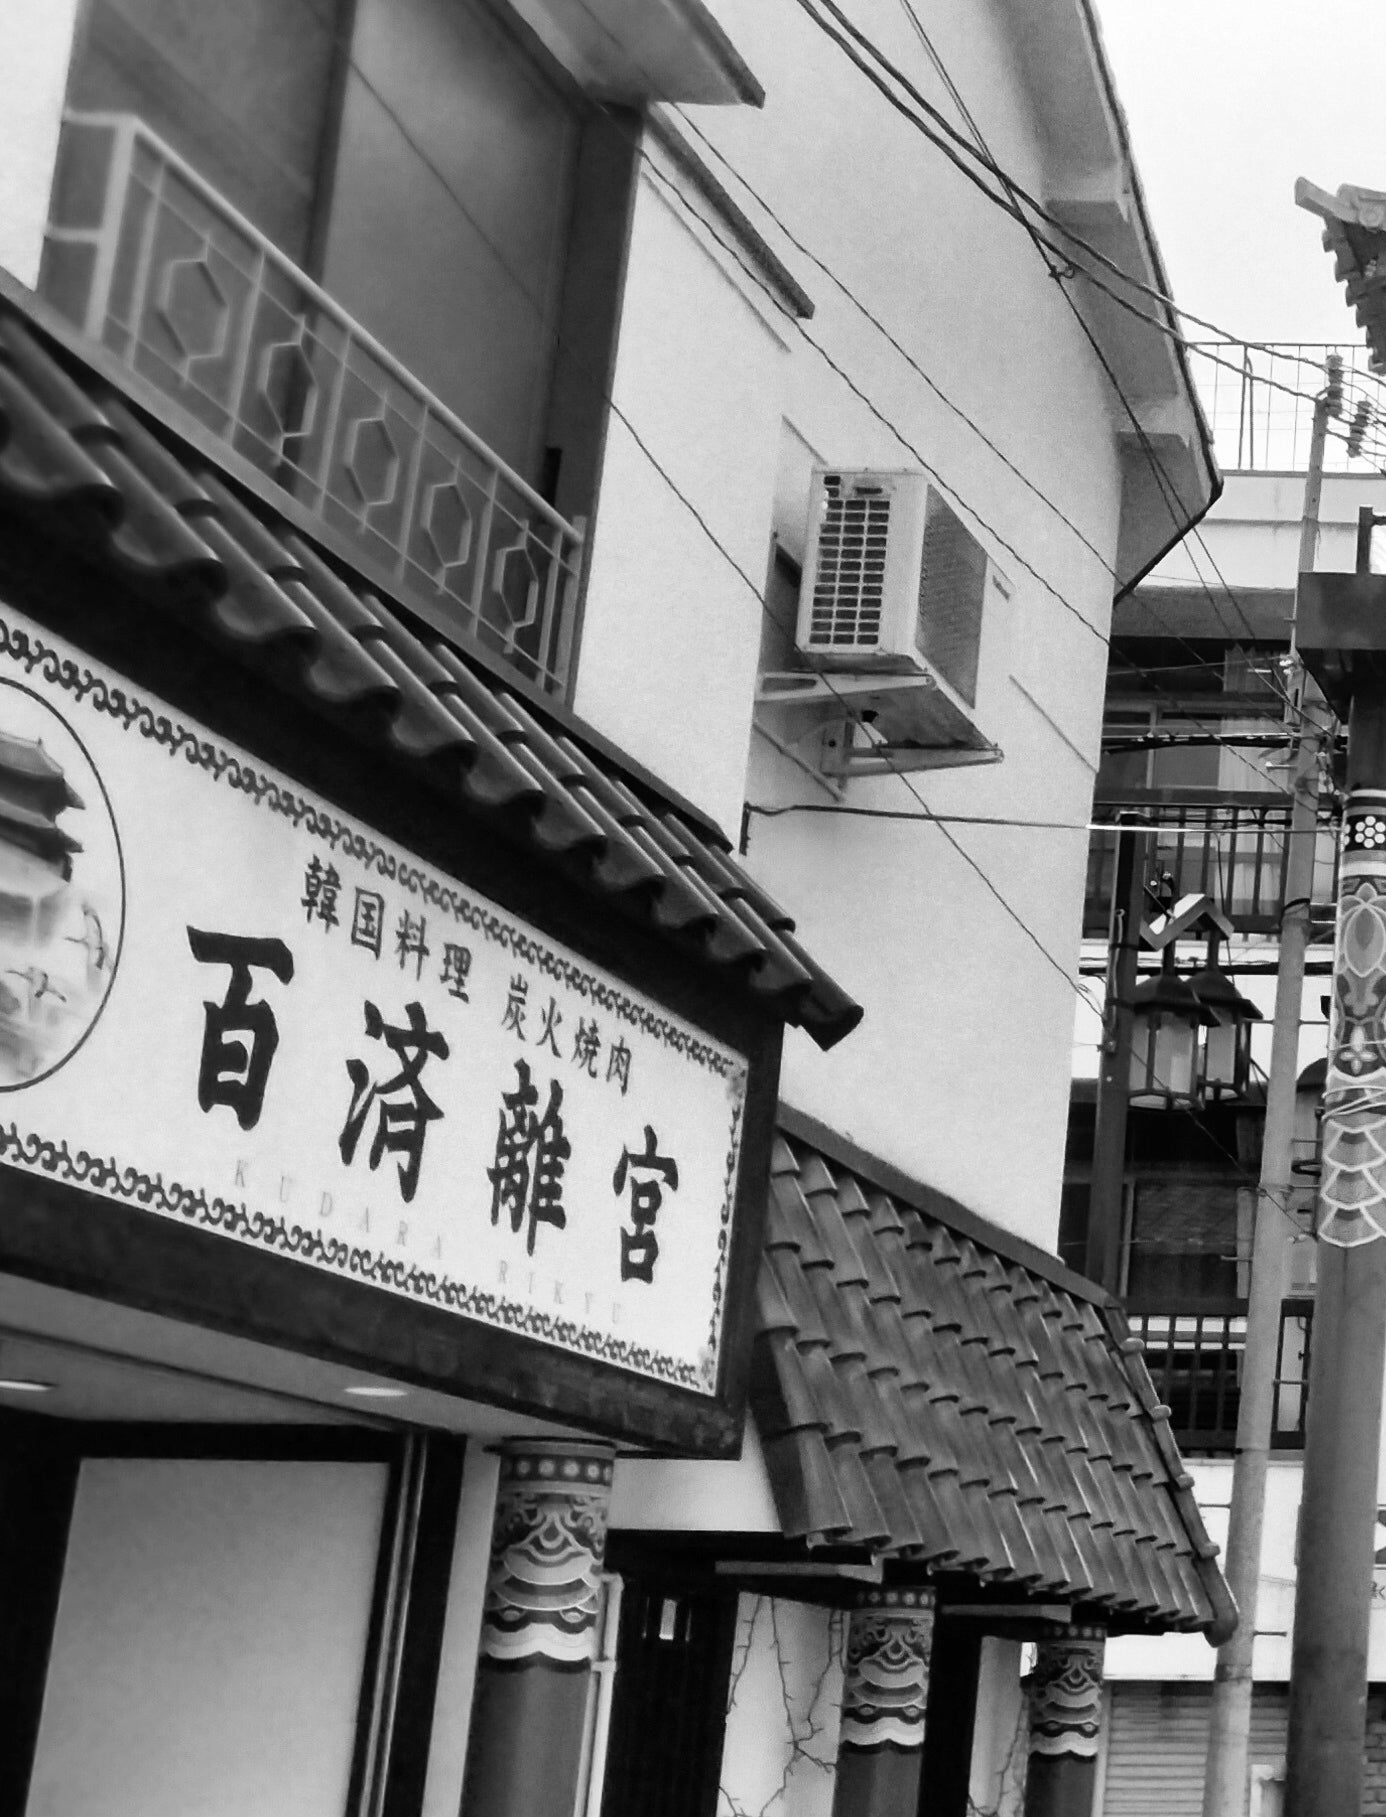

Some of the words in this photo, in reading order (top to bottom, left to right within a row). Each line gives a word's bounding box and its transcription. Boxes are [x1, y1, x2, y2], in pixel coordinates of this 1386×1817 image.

[187, 925, 679, 1284] 百済離宮
[301, 854, 472, 1005] 韓国料理
[501, 973, 633, 1096] 炭火焼肉
